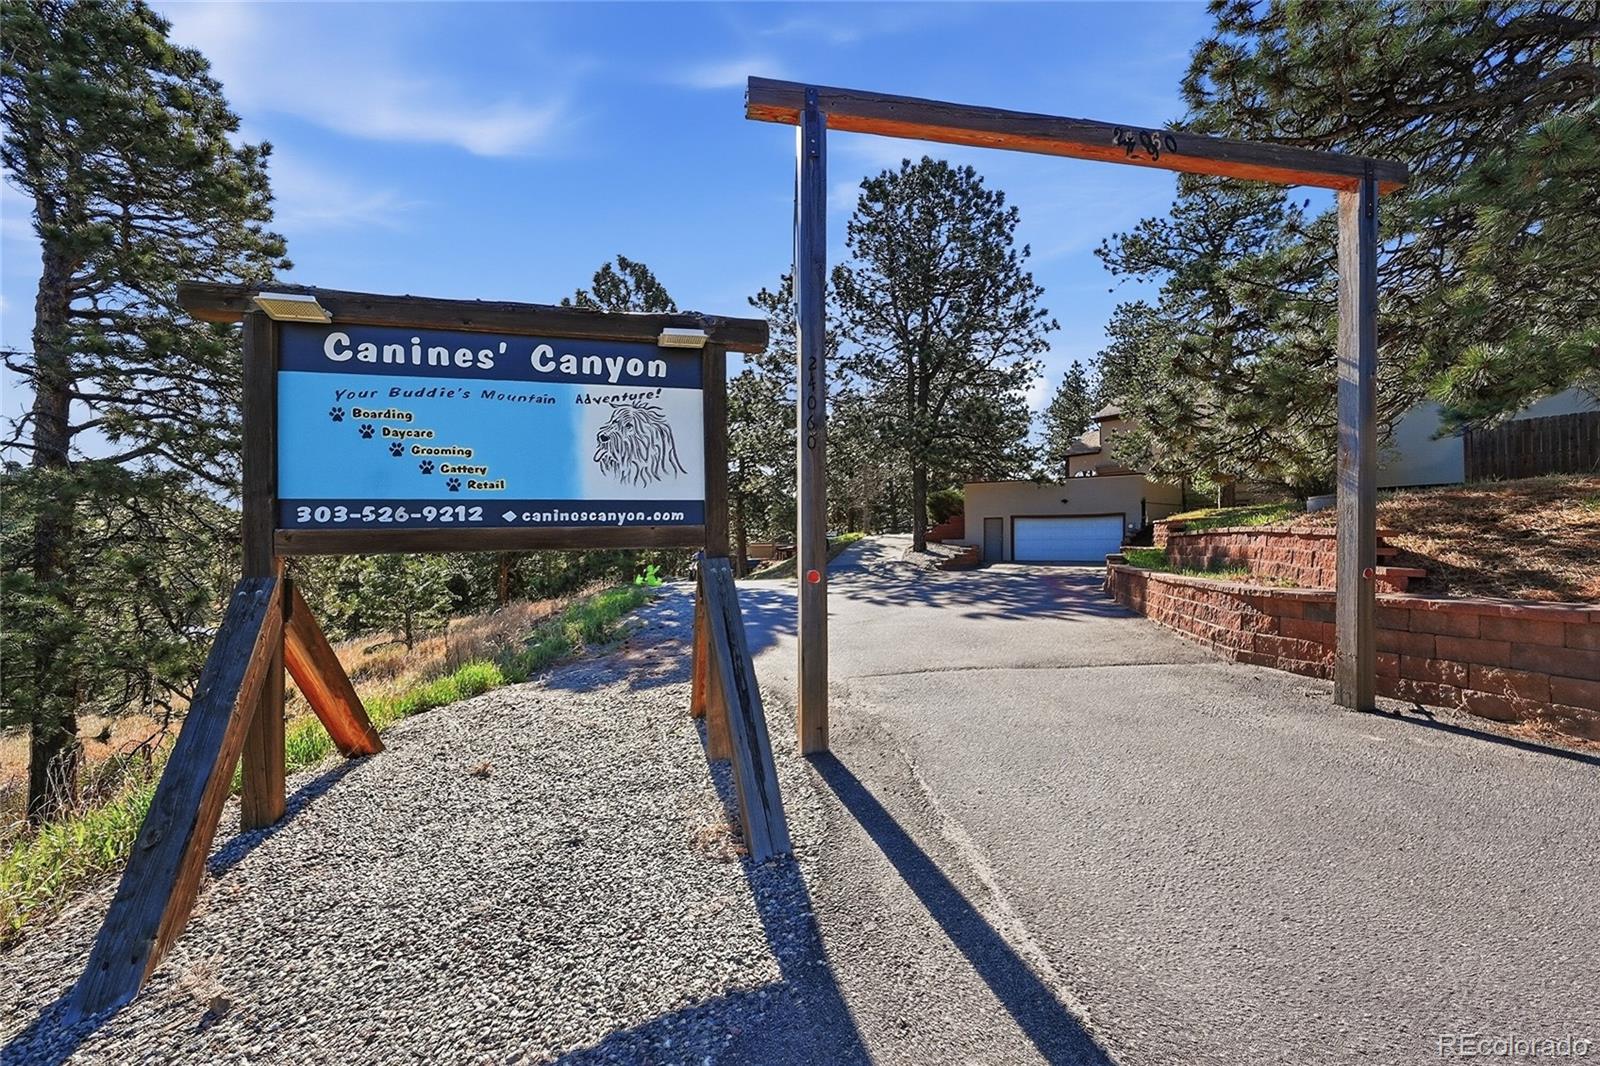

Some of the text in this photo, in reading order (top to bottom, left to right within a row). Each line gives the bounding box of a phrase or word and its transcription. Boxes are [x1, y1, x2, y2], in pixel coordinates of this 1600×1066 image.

[323, 331, 668, 383] Canines' Canyon
[335, 386, 661, 405] Your Buddie's Mountain Adventure!
[806, 356, 817, 450] 24060
[352, 407, 413, 422] Boarding
[381, 426, 434, 439] Daycare
[411, 445, 473, 458] Grooming
[440, 463, 487, 476] Cattery
[466, 479, 505, 491] Retail
[297, 505, 484, 524] 303-526-9212
